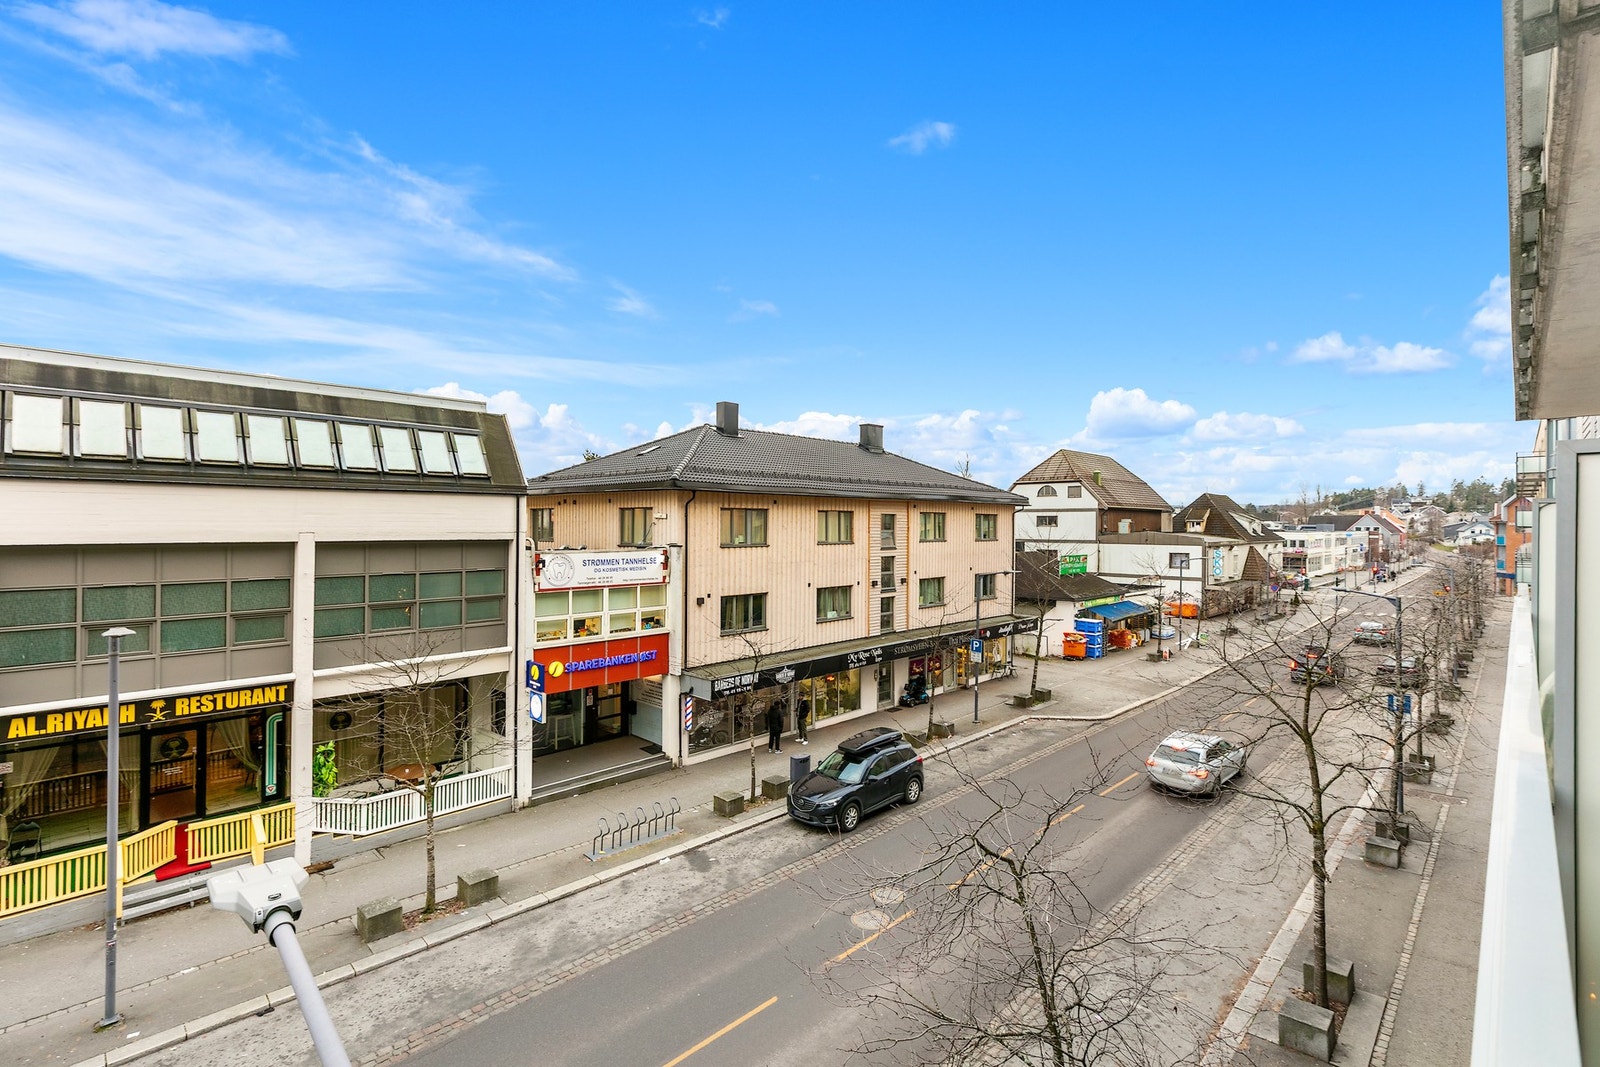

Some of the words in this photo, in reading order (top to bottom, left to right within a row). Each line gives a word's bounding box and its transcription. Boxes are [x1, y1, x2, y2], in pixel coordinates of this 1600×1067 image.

[582, 558, 619, 567] STRØMMEN
[621, 557, 657, 565] TANNHELSE
[973, 640, 980, 650] P
[565, 653, 638, 673] SPAREBANKEN
[640, 650, 657, 662] ØST
[175, 684, 287, 716] RESTURANT
